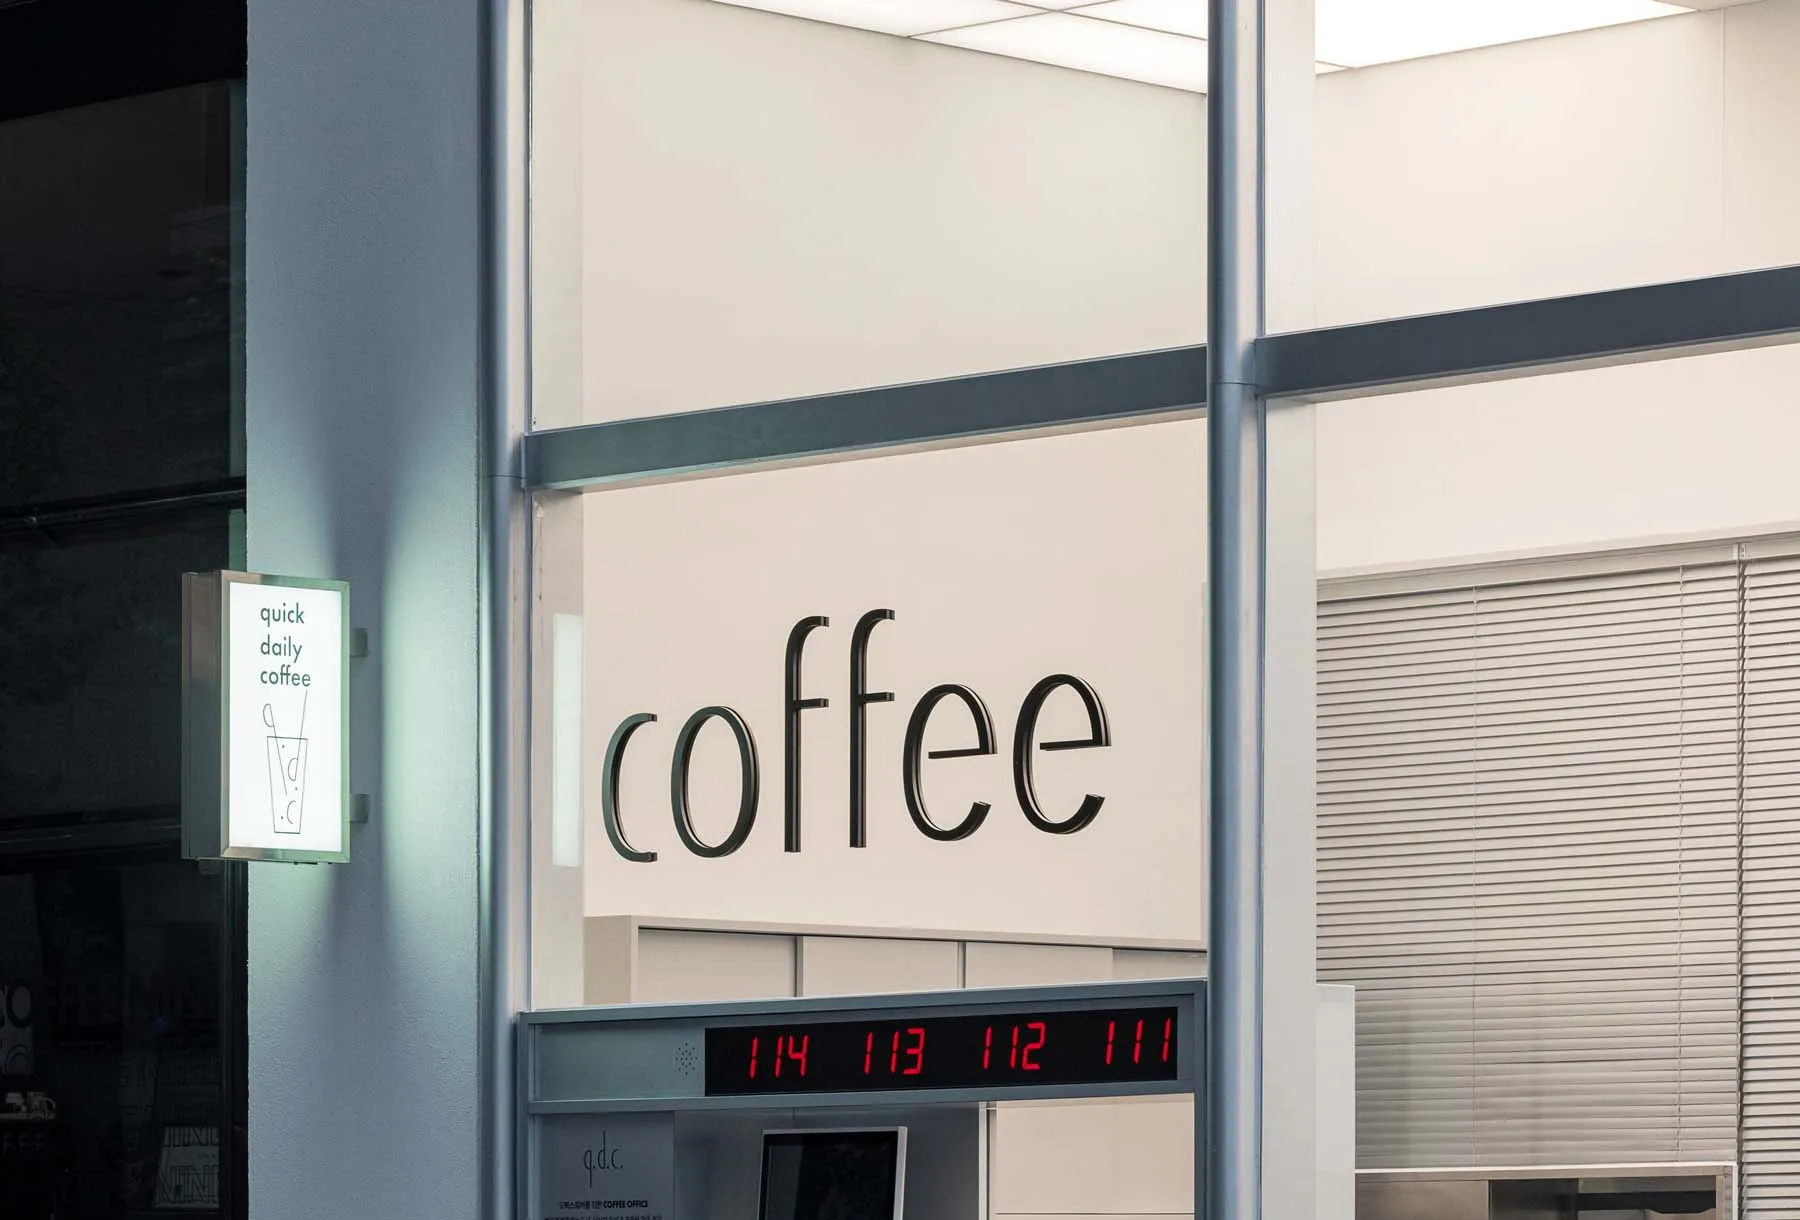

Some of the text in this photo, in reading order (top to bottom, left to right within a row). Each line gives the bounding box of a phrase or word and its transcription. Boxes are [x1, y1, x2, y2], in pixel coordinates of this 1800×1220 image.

[259, 602, 305, 627] quick
[259, 633, 303, 663] daily
[259, 664, 311, 688] coffee
[602, 608, 1112, 863] coffee
[748, 1017, 1173, 1079] 114 113 112 111
[603, 1199, 626, 1209] COFFEE
[626, 1199, 649, 1209] OFFICE
